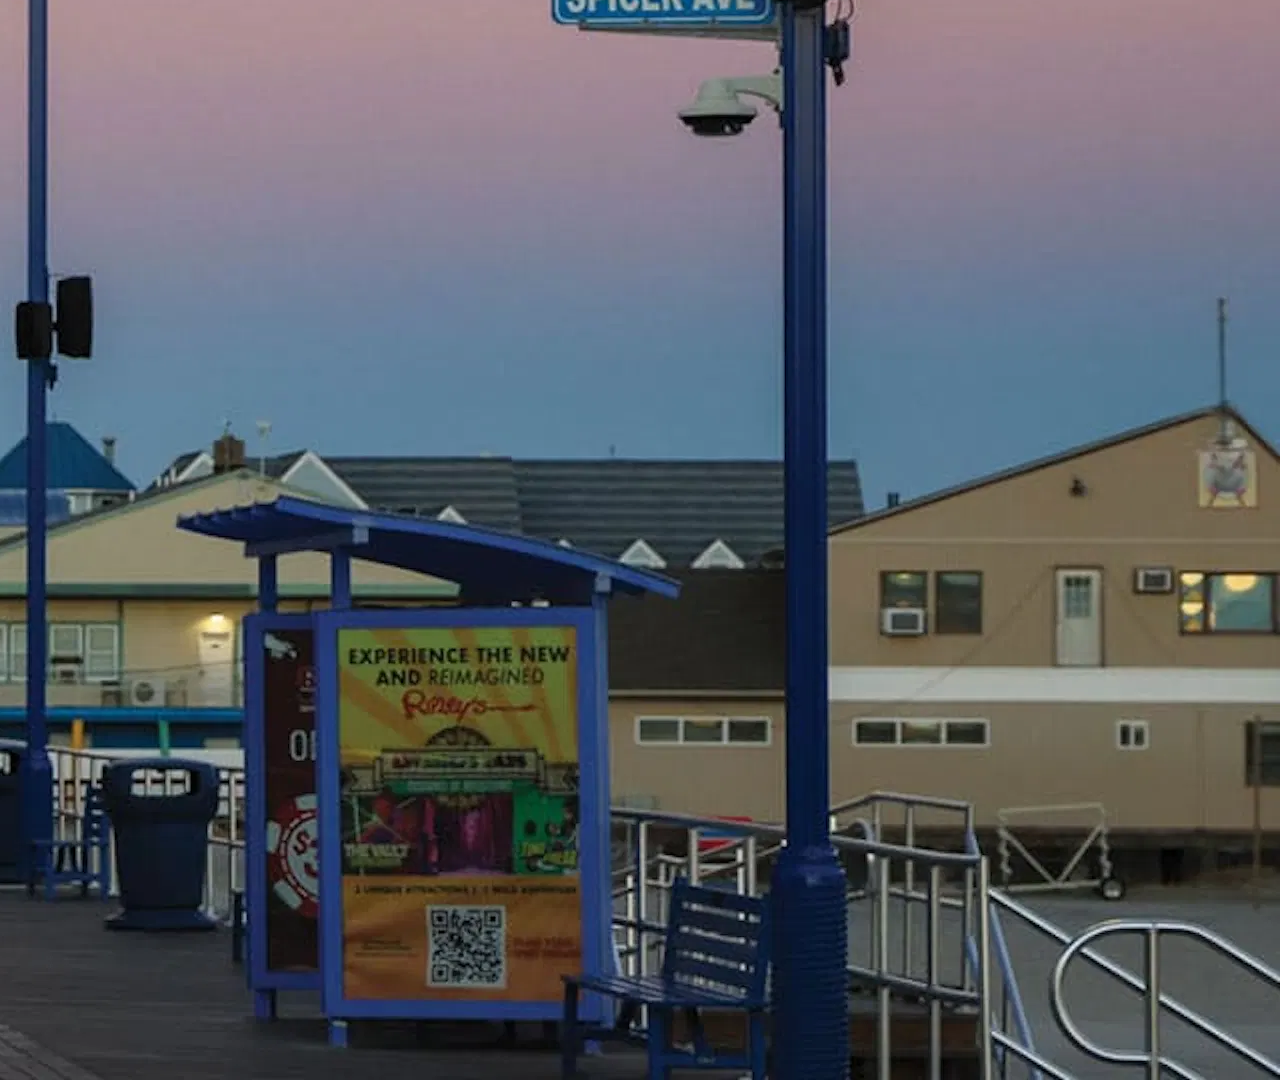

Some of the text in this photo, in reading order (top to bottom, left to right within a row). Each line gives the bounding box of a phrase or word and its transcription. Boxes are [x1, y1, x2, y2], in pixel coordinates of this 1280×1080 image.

[348, 646, 571, 665] EXPERIENCE THE NEW
[376, 667, 545, 686] AND REIMAGINED
